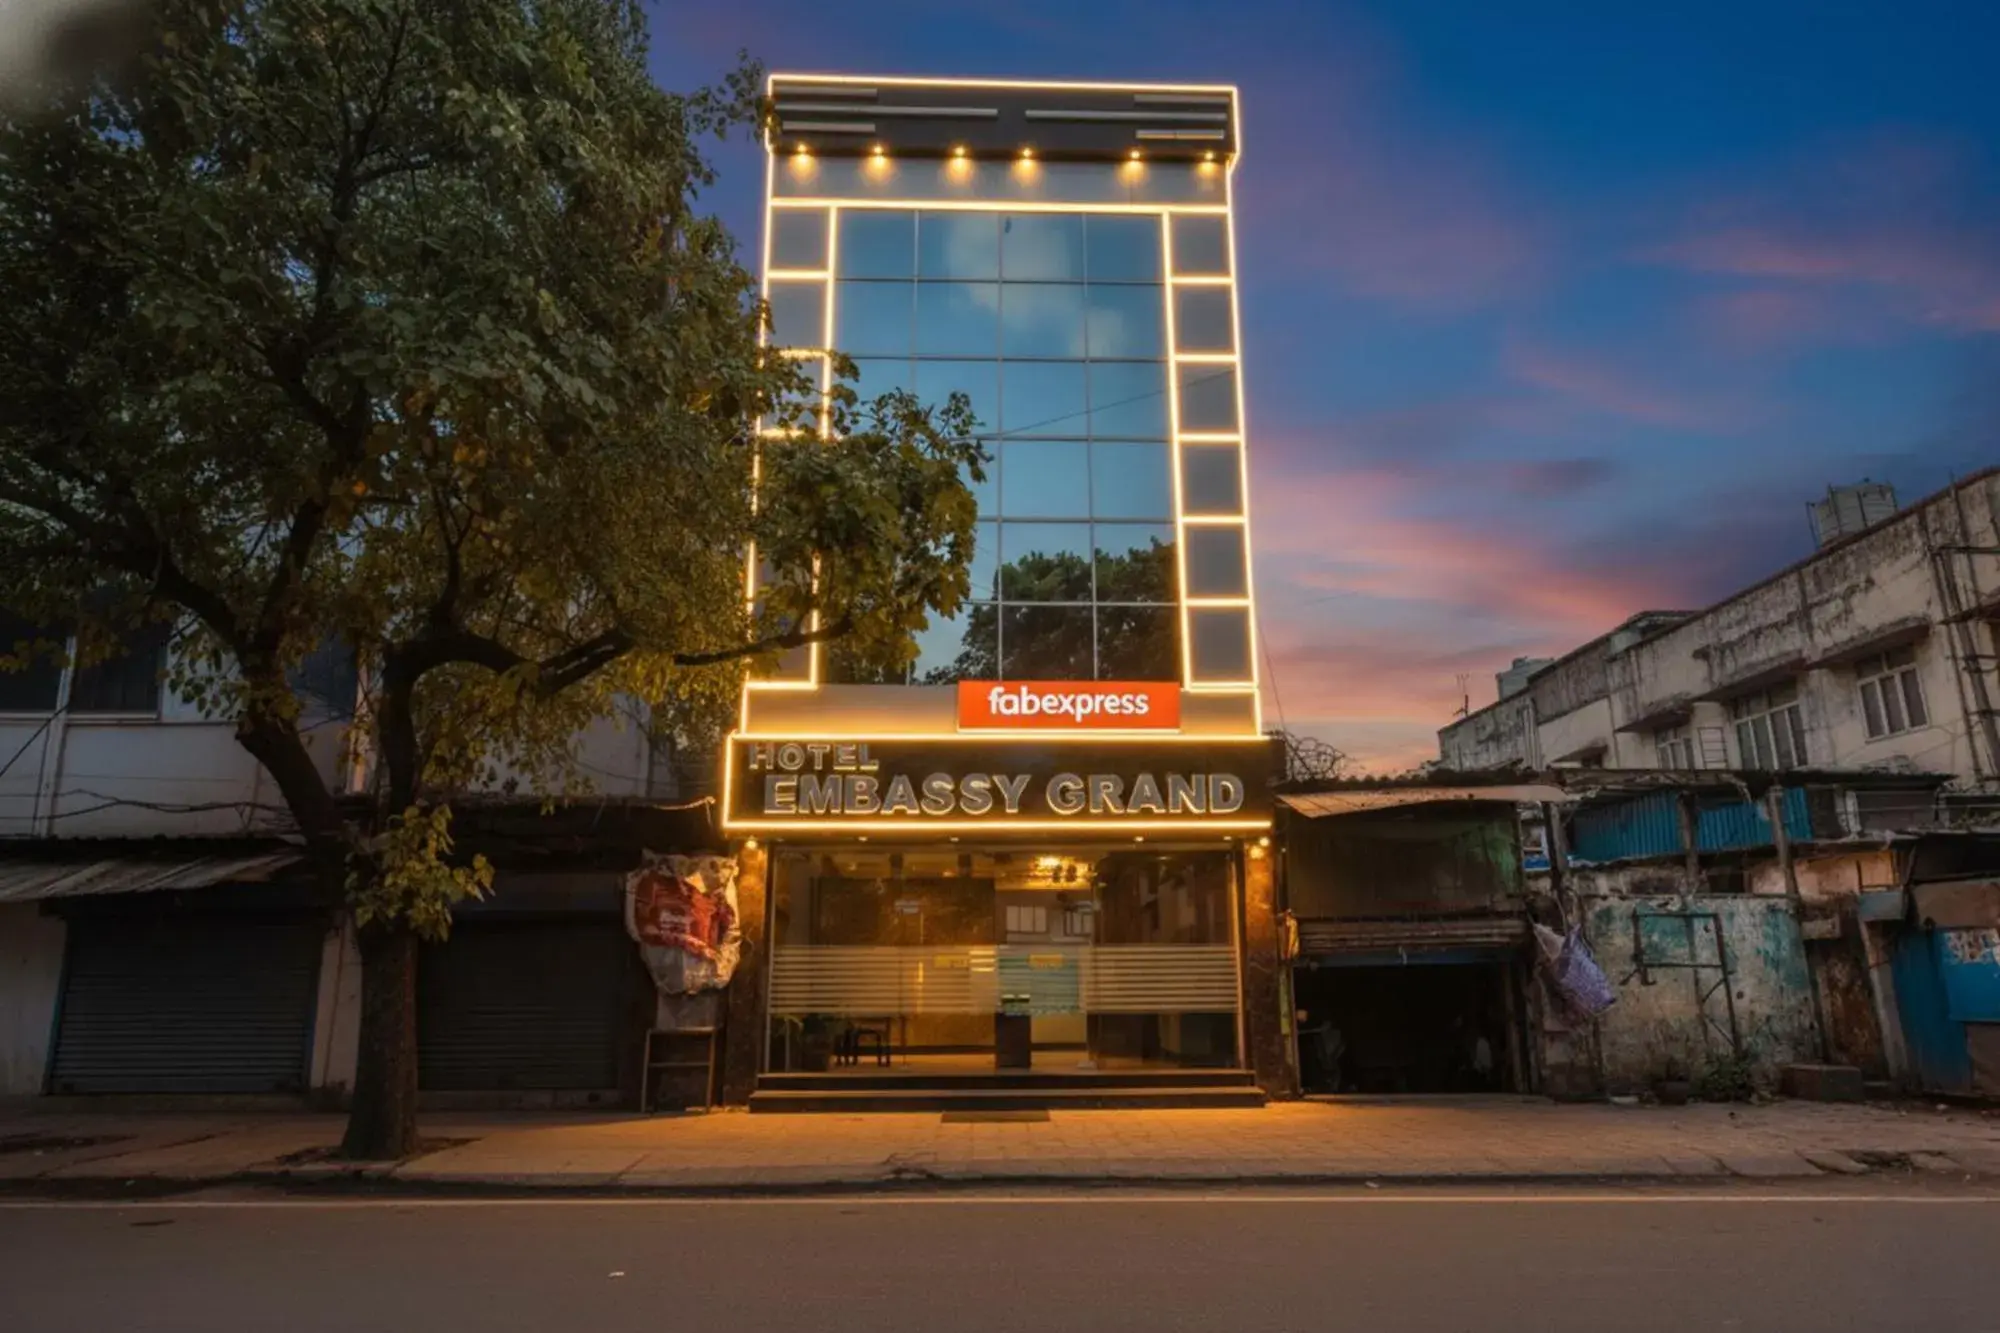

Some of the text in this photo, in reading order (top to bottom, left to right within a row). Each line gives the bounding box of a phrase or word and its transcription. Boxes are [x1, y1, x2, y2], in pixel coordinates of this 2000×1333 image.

[988, 687, 1149, 722] fabexpress
[749, 743, 879, 770] HOTEL
[764, 773, 1244, 815] EMBASSY GRAND
